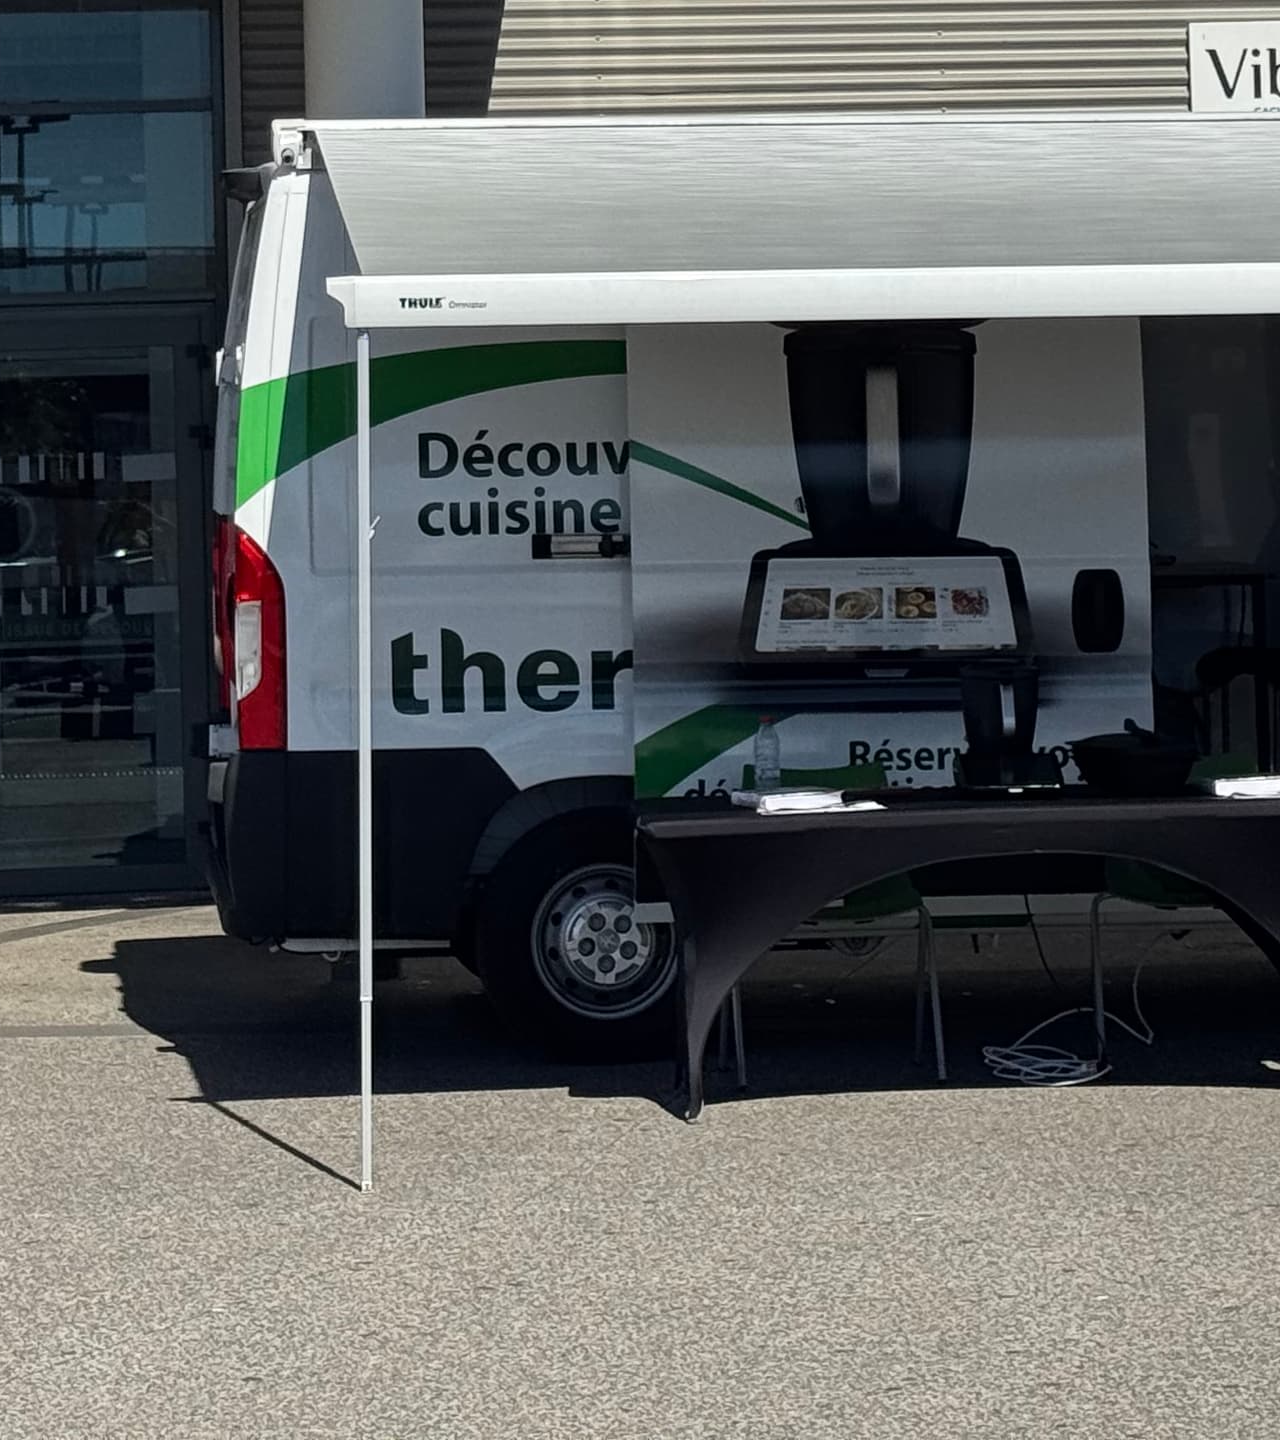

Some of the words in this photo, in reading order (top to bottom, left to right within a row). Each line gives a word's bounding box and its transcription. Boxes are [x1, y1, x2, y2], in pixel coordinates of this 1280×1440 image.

[399, 297, 443, 309] THULE
[418, 430, 630, 479] Découv
[418, 487, 622, 537] cuisine
[390, 627, 634, 716] ther
